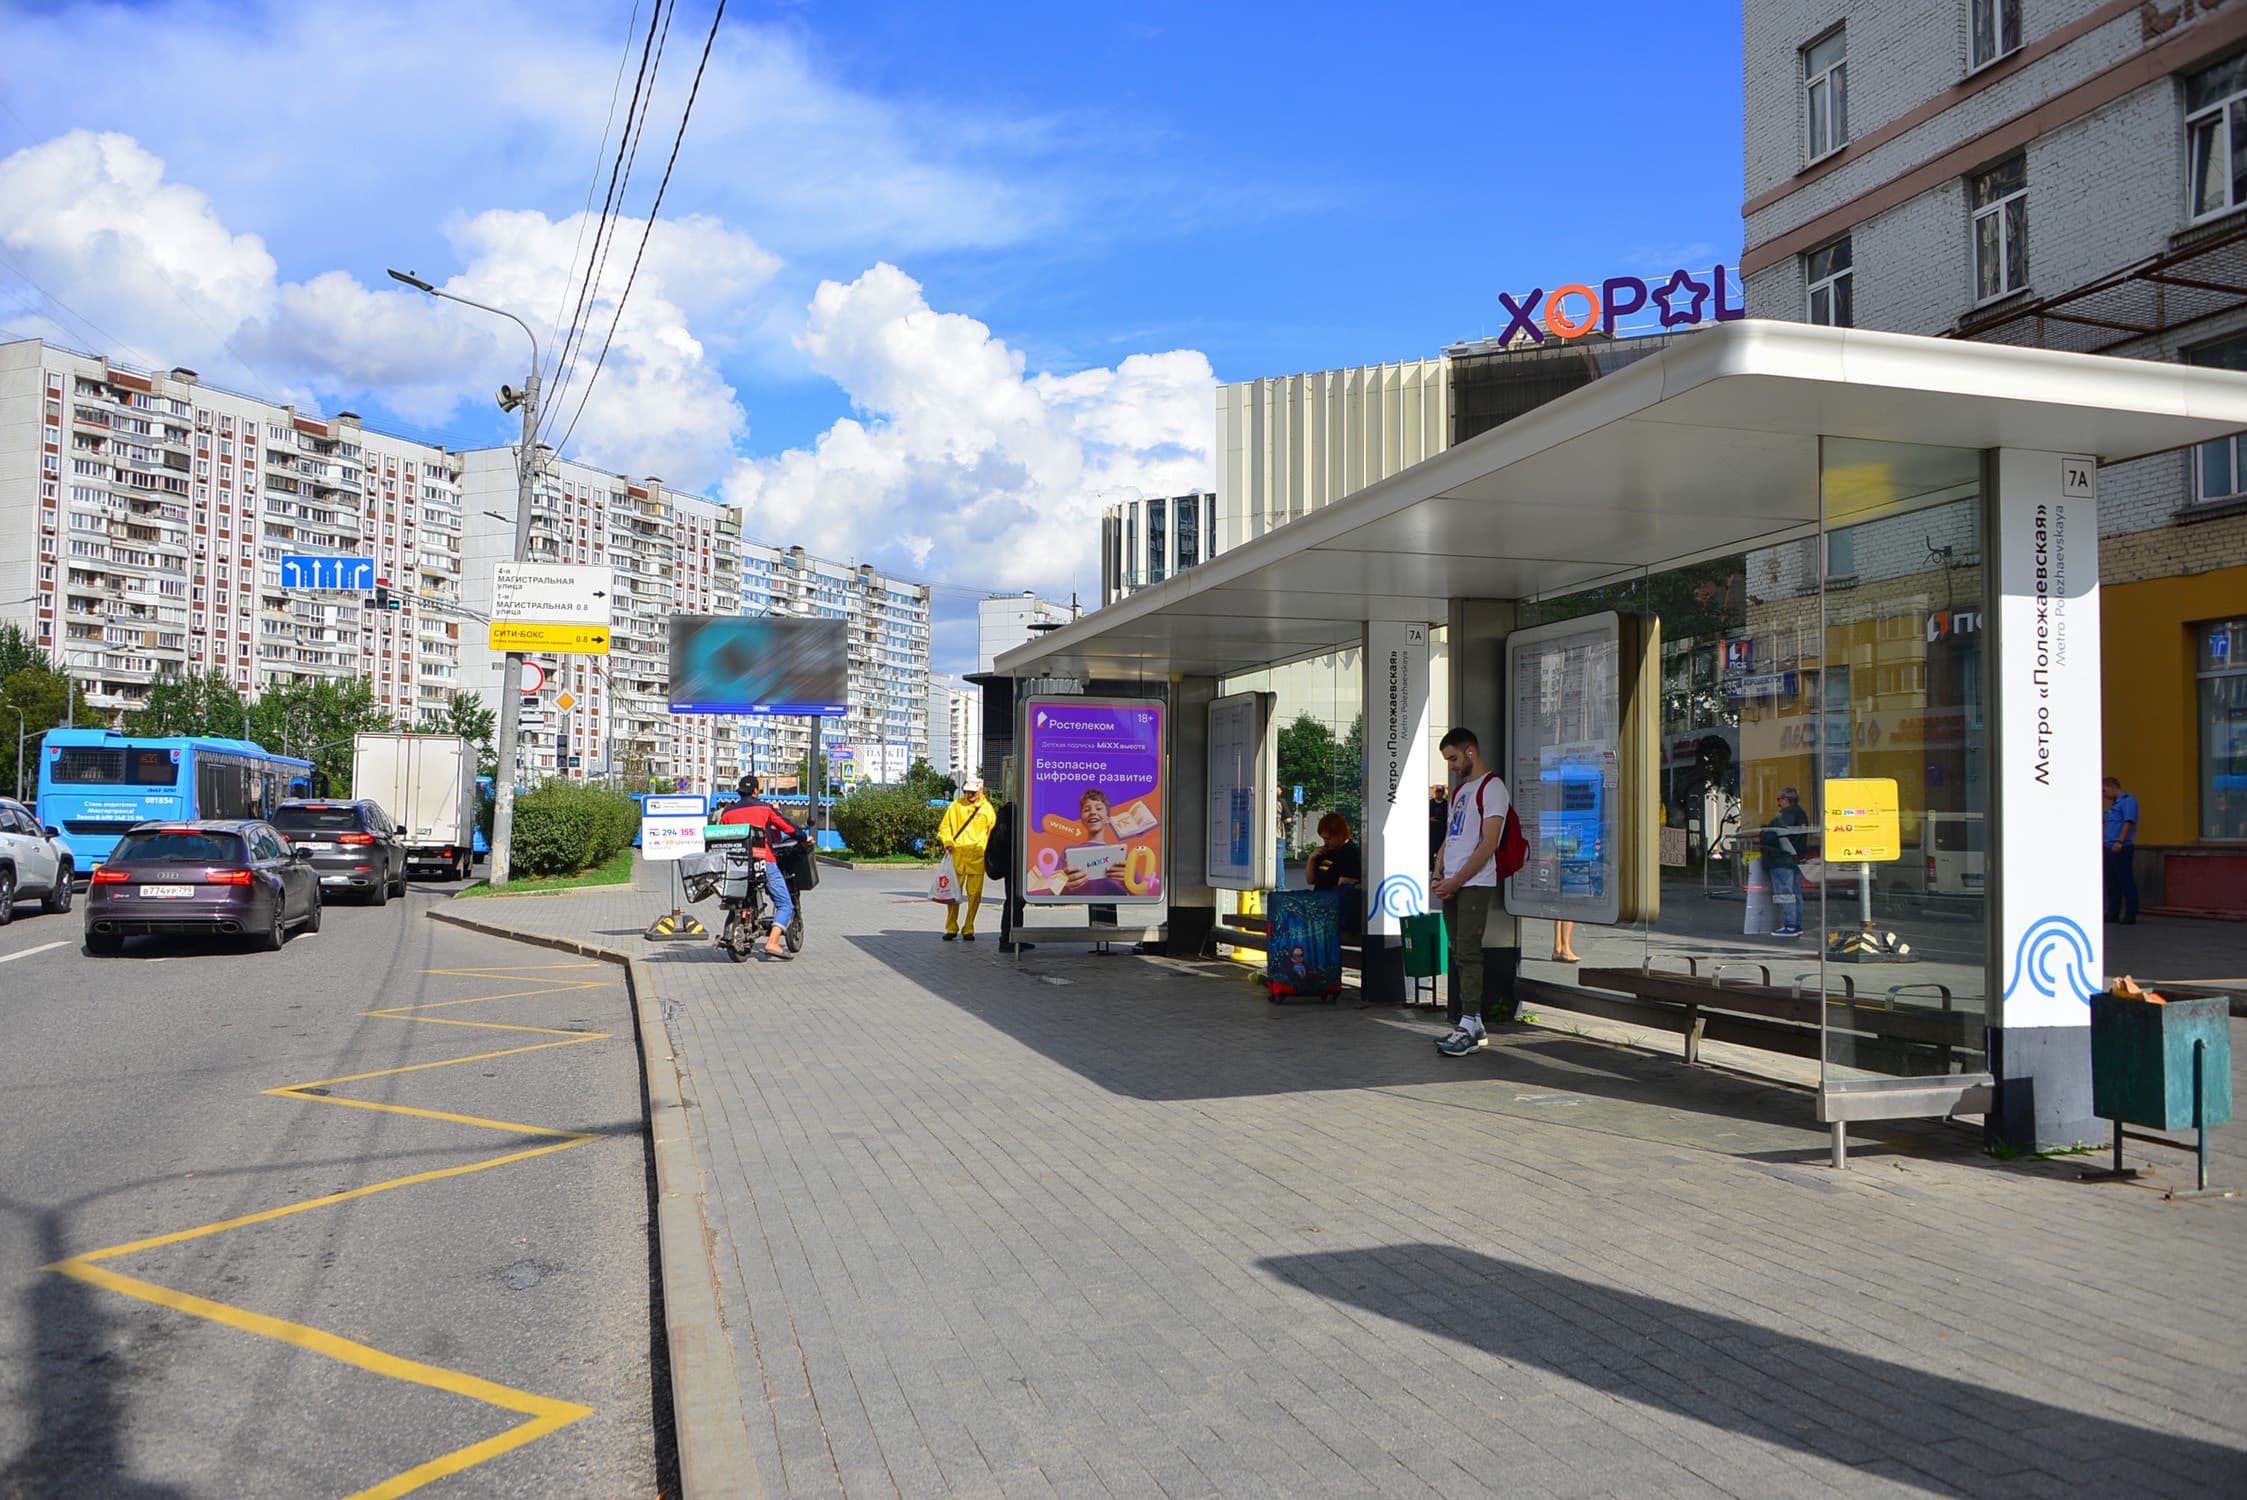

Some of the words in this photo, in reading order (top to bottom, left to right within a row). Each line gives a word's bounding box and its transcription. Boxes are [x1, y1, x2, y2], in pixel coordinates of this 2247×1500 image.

[2054, 504, 2065, 617] Polezhaevskaya
[498, 576, 575, 585] МАГИСТРАЛЬНАЯ
[496, 602, 573, 611] МАГИСТРАЛЬНАЯ
[2033, 505, 2050, 698] «Полежаевская»
[494, 630, 545, 639] СИТИ-БОКС
[2056, 622, 2067, 666] Metro
[1387, 651, 1398, 757] «Полежаевская»
[1049, 719, 1115, 731] Ростелеком
[1138, 713, 1154, 723] 18+
[2034, 707, 2053, 786] Метро
[1036, 758, 1107, 770] Безопасное
[1036, 773, 1096, 784] цифровое
[1099, 772, 1153, 783] развитие
[1387, 760, 1399, 804] Метро
[681, 828, 694, 836] 155
